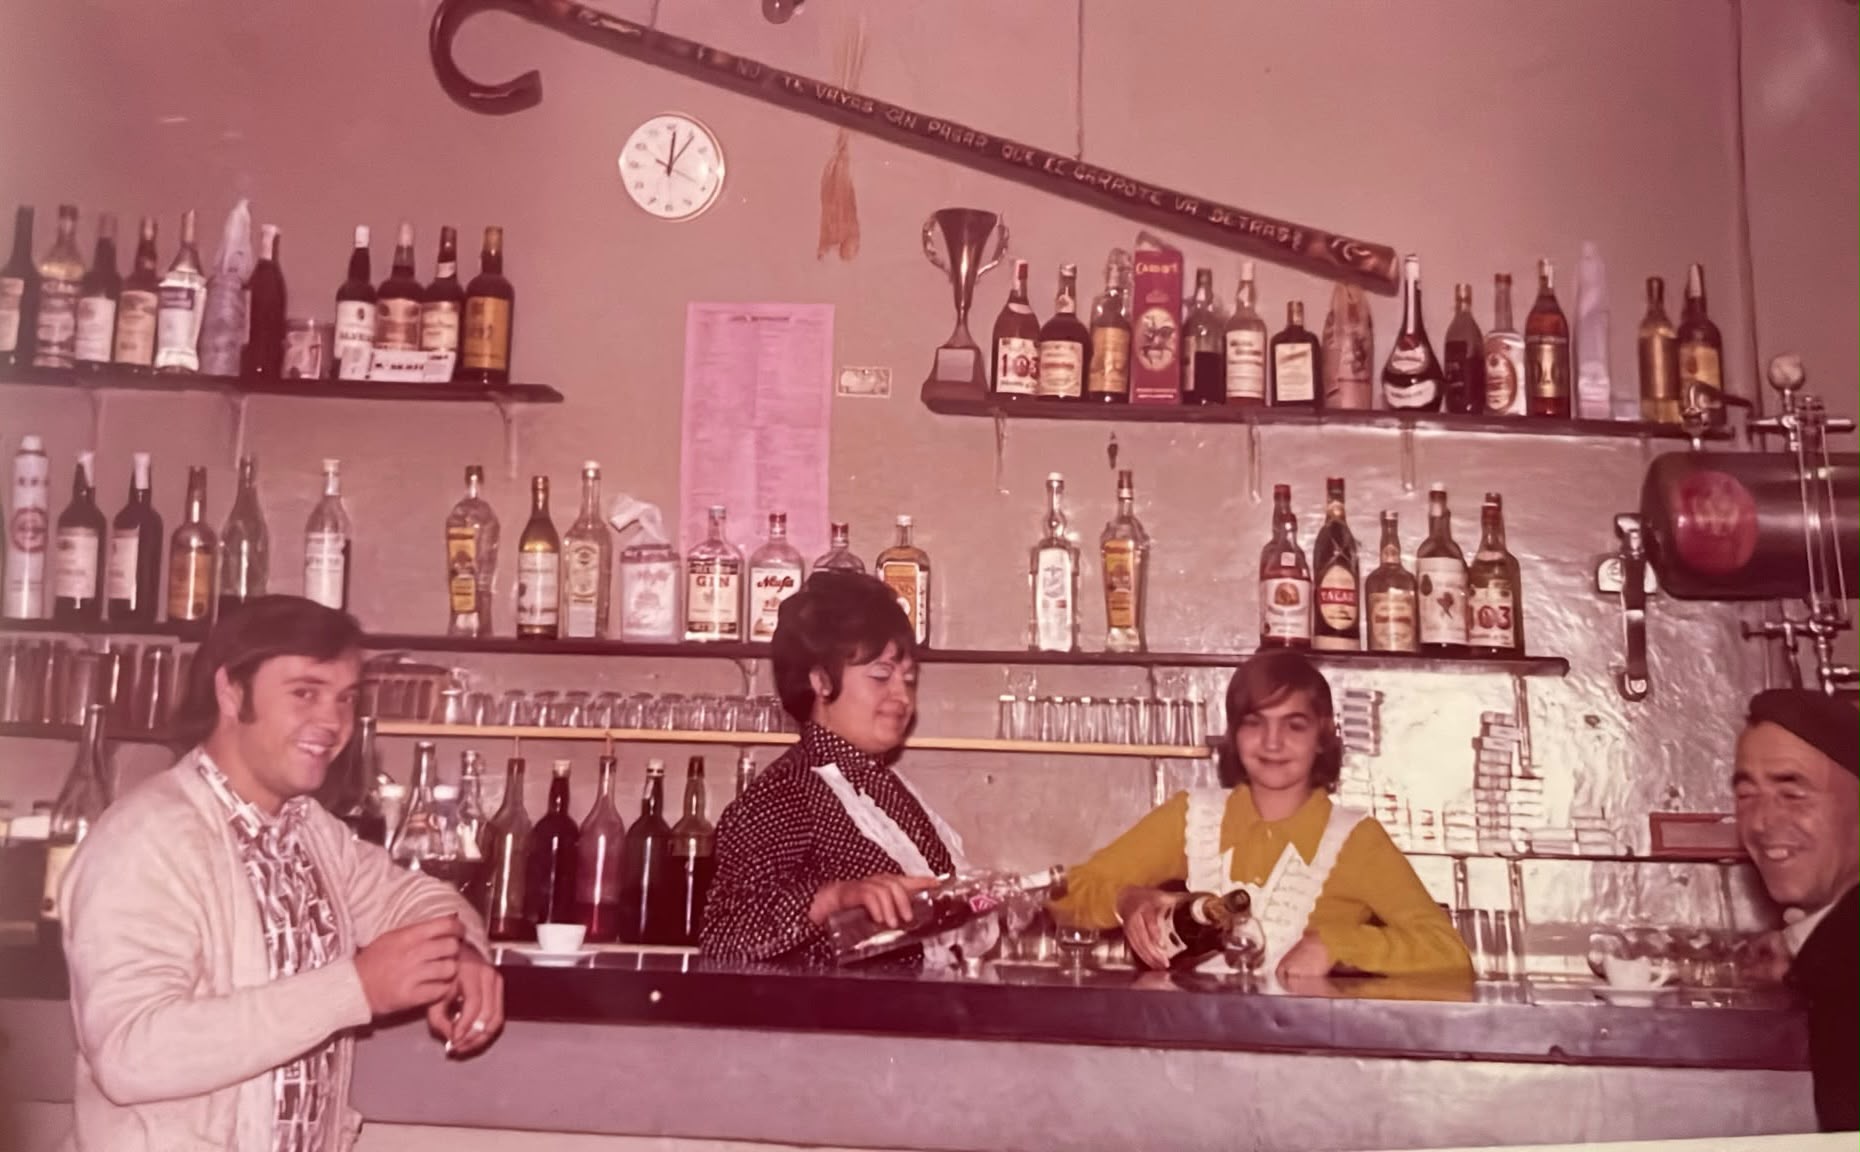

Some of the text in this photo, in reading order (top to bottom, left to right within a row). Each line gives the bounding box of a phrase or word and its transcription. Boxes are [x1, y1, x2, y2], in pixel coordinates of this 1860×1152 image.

[928, 120, 988, 148] PAGAR
[1002, 144, 1036, 167] QUE
[1074, 164, 1162, 206] GARROTE
[1174, 196, 1199, 215] VA
[1002, 353, 1040, 379] 103
[696, 575, 730, 588] GIN
